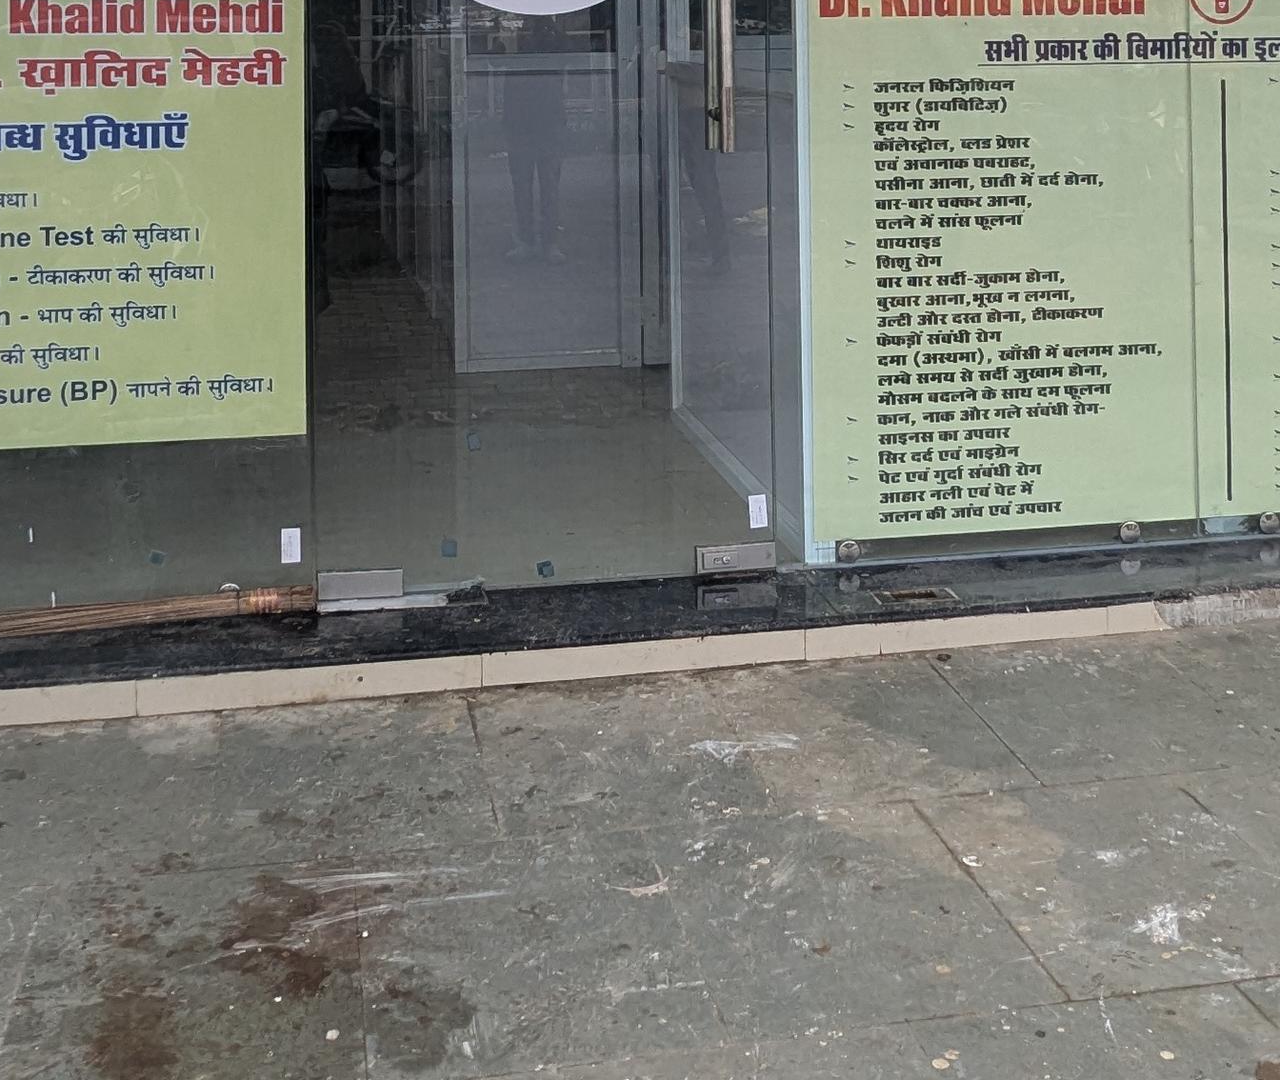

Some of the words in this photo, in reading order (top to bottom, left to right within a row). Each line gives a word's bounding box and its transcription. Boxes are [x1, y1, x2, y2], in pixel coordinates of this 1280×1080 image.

[984, 33, 1028, 62] सभी
[1035, 37, 1088, 64] प्रकार
[1092, 32, 1120, 61] की
[1128, 30, 1219, 60] बिमारियों
[1221, 36, 1247, 58] का
[180, 48, 287, 88] मेहदी
[873, 82, 925, 93] जनरल
[912, 117, 941, 131] रोग
[54, 112, 190, 161] सुविधाएँ
[39, 226, 94, 246] Test
[101, 223, 128, 244] की
[915, 253, 943, 267] रोग
[26, 264, 113, 285] टीकाकरण
[115, 261, 143, 283] की
[37, 308, 74, 323] भाप
[77, 302, 104, 323] की
[61, 379, 117, 407] (BP)
[126, 376, 172, 398] नापने
[175, 375, 202, 396] की
